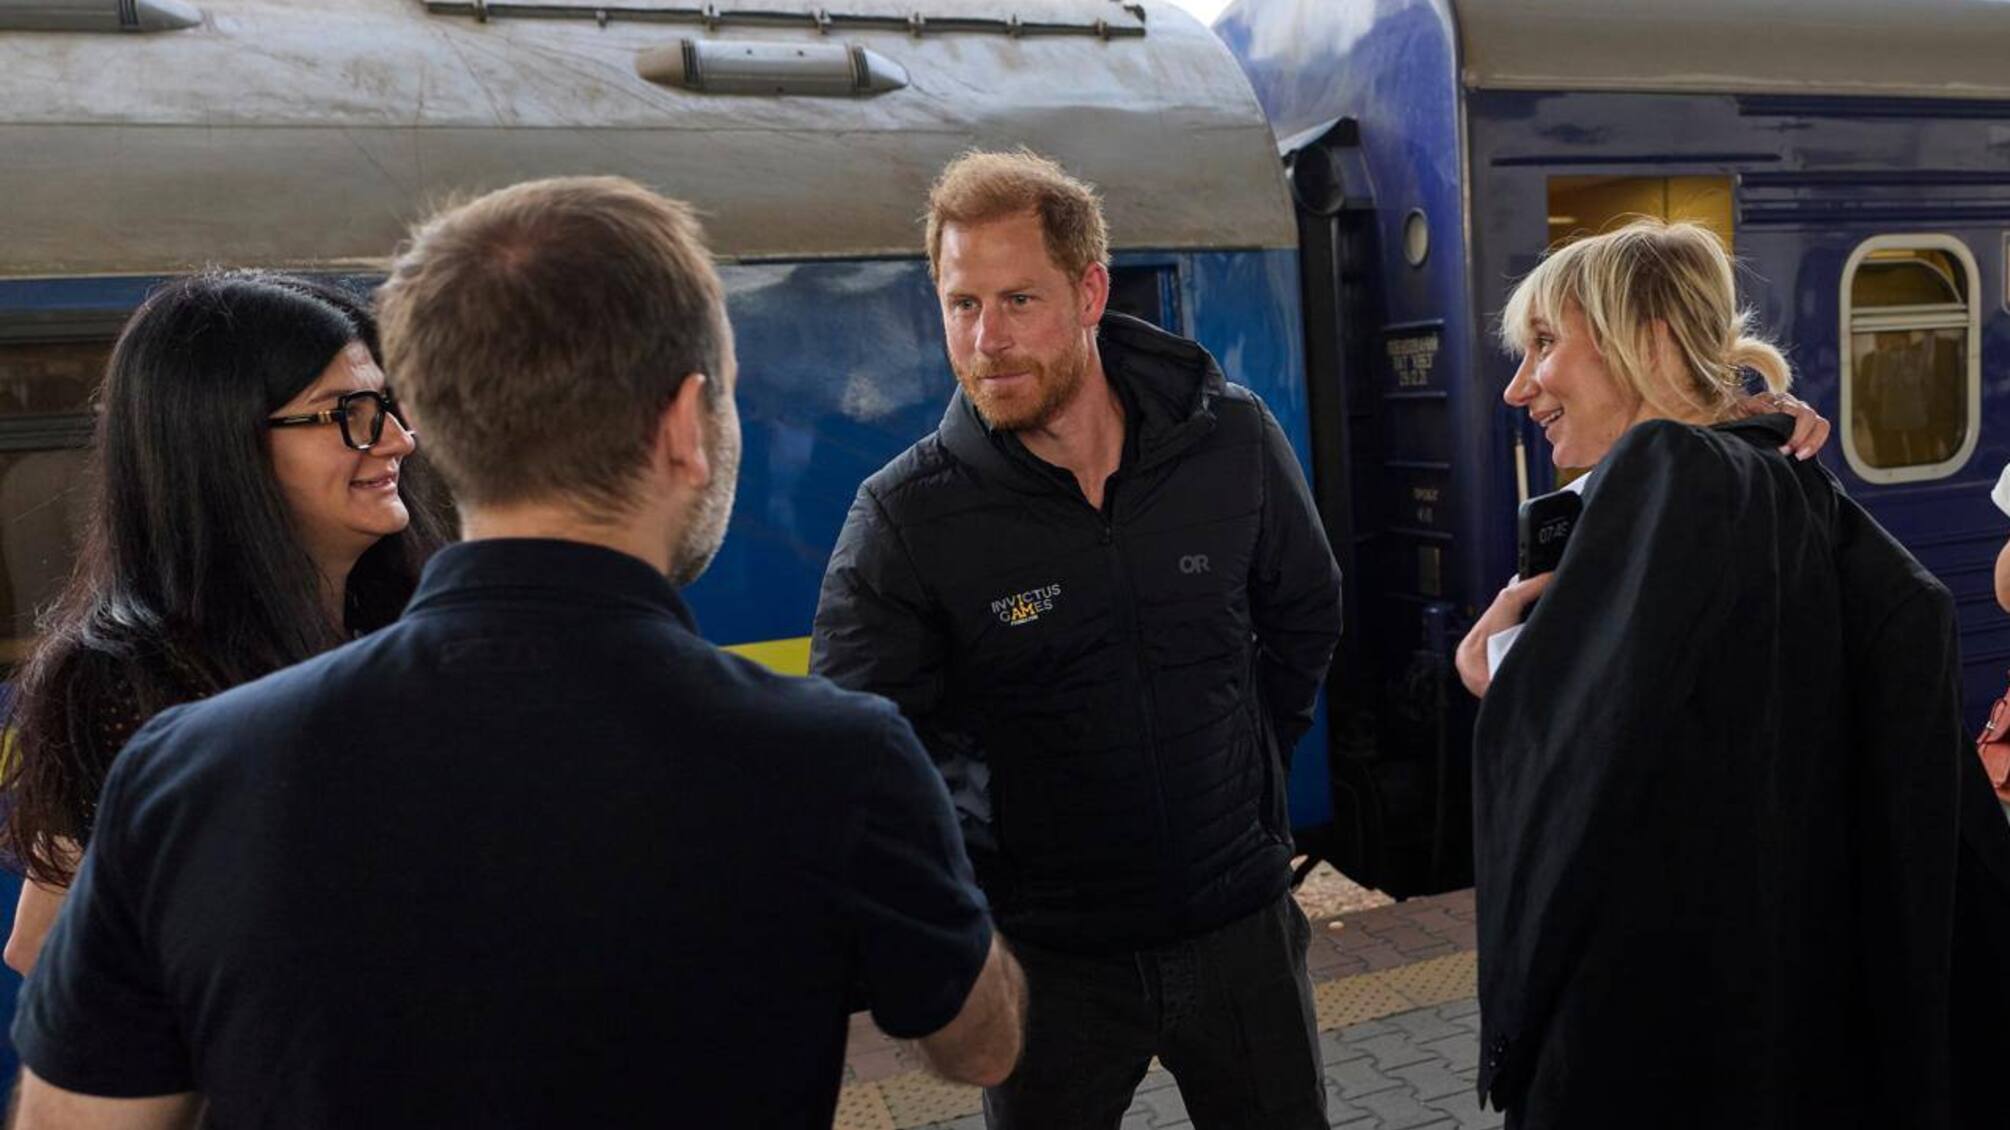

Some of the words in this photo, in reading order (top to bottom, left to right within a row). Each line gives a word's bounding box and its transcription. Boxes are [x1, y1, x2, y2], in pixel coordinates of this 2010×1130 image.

[1180, 554, 1210, 574] OR
[991, 584, 1062, 614] INVICTUS
[1000, 598, 1054, 622] GAMES
